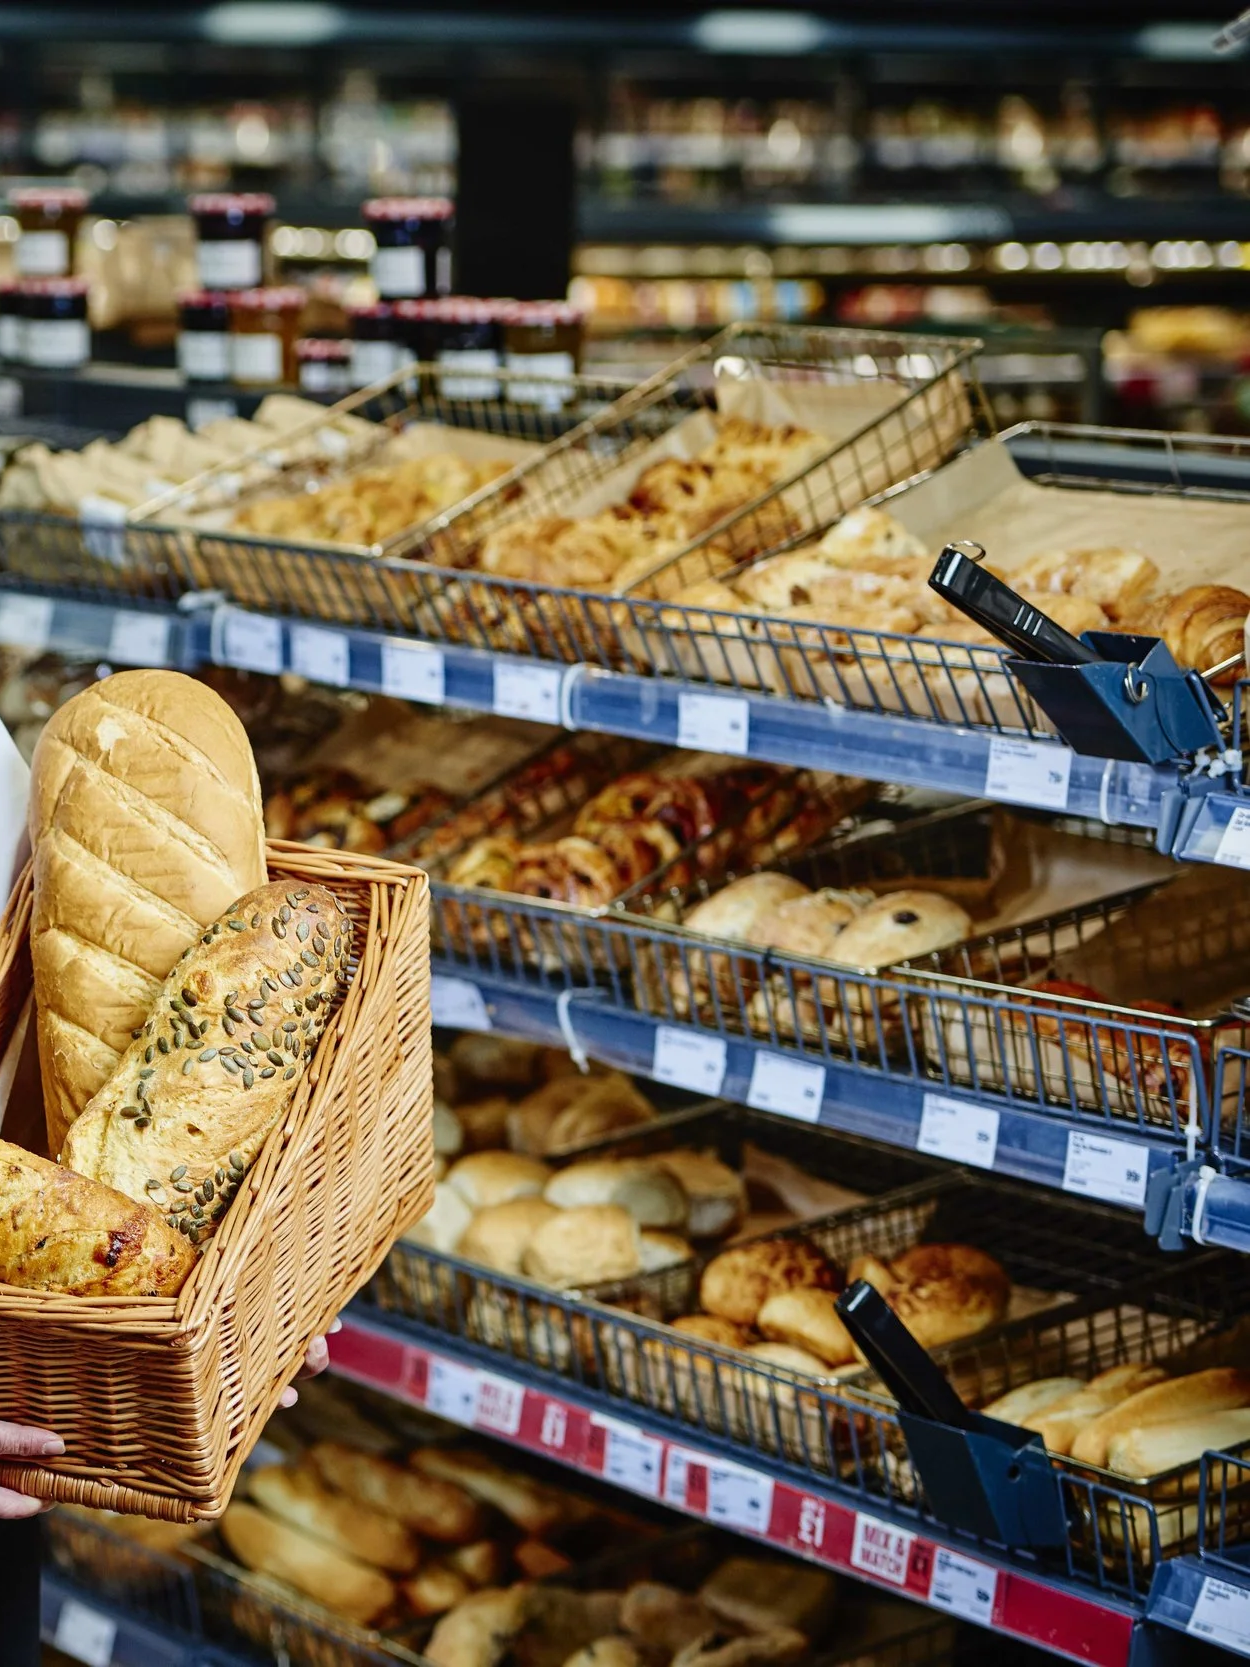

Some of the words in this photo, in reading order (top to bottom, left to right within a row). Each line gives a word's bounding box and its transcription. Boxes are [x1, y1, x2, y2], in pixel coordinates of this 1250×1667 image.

[863, 1523, 891, 1549] MIX
[894, 1537, 905, 1557] &
[860, 1546, 904, 1576] MATCH
